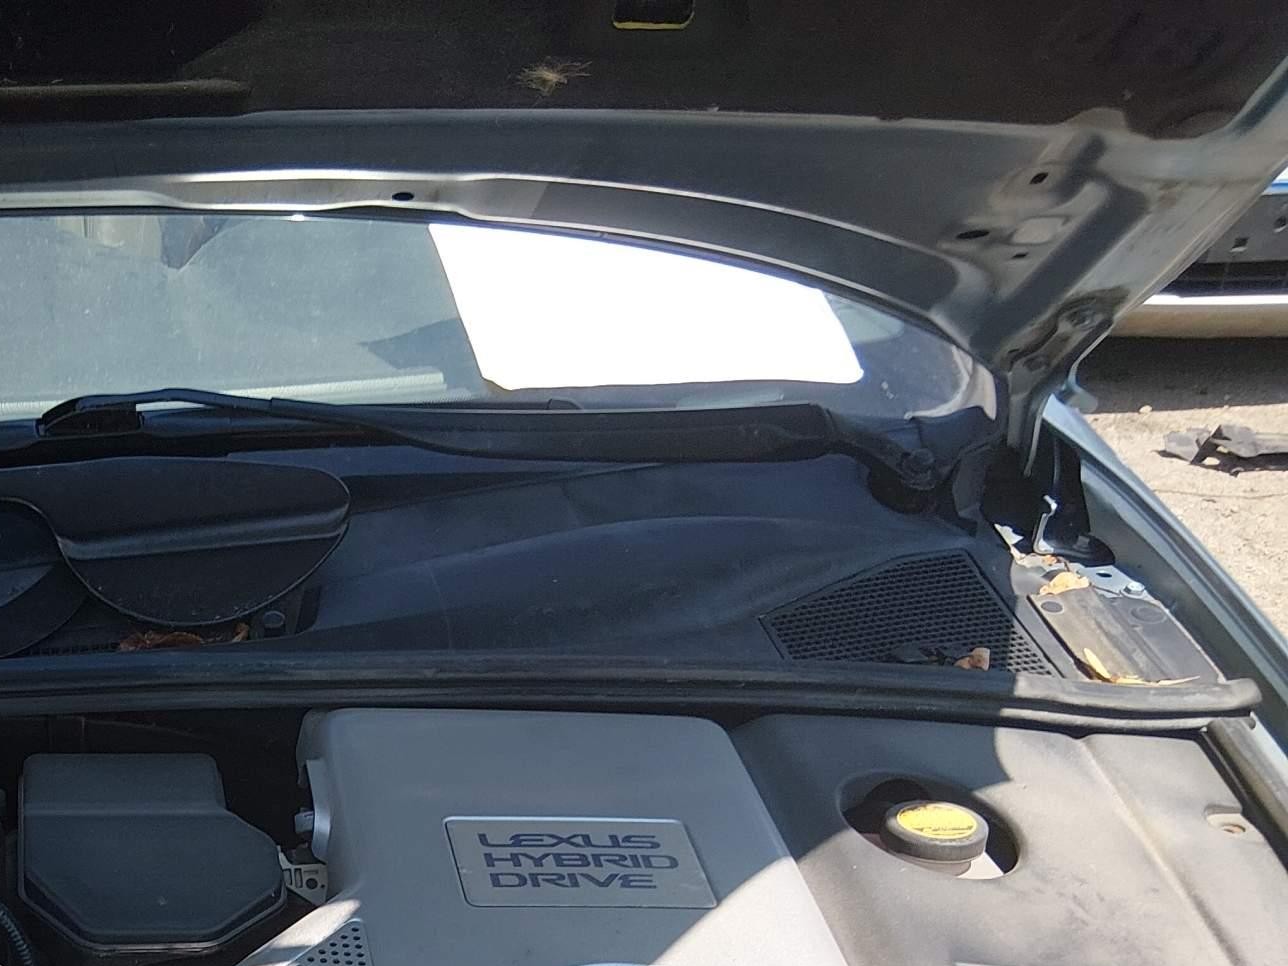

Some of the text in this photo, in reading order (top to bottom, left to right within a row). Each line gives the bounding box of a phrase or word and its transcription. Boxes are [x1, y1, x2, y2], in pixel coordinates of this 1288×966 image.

[477, 833, 661, 849] LEXUS
[483, 852, 679, 869] HYBRID
[489, 872, 657, 889] DRIVE
